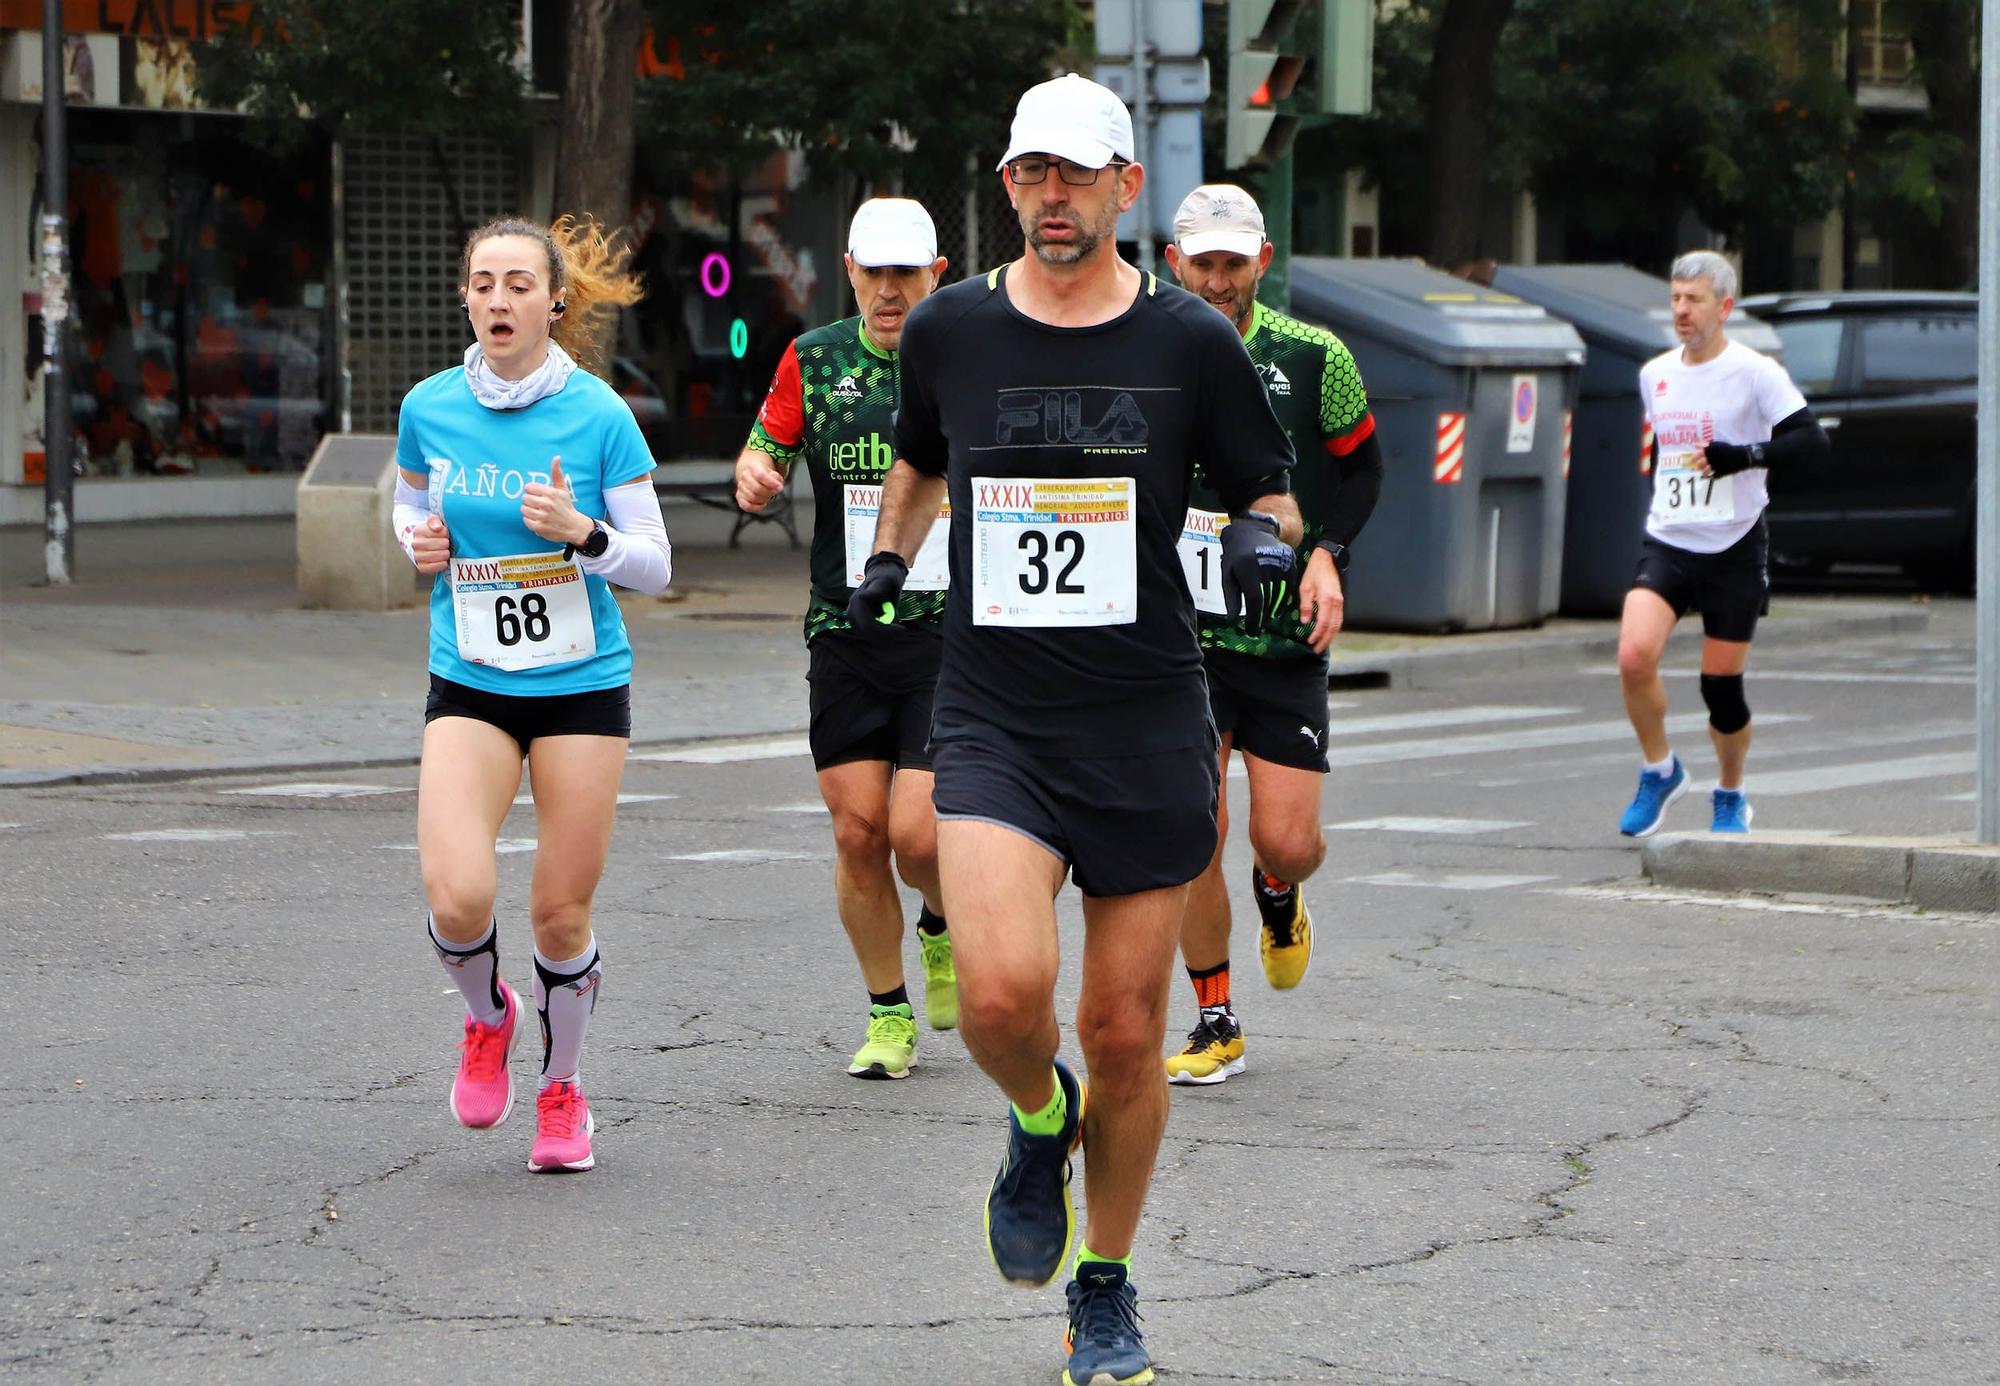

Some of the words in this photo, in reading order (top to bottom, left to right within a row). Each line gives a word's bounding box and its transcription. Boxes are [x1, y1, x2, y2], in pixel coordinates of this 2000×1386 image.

[996, 392, 1149, 444] FILA
[829, 432, 893, 471] Getb
[850, 490, 880, 506] XXXI
[979, 485, 1032, 508] XXXIX
[1669, 475, 1715, 508] 317
[978, 511, 1000, 523] Colegio
[1060, 511, 1128, 522] TRINITARIOS
[1186, 513, 1214, 533] XXIX
[457, 563, 501, 581] XXXIX
[1018, 530, 1085, 595] 32
[522, 573, 579, 588] TRINITARIOS
[494, 592, 551, 647] 68
